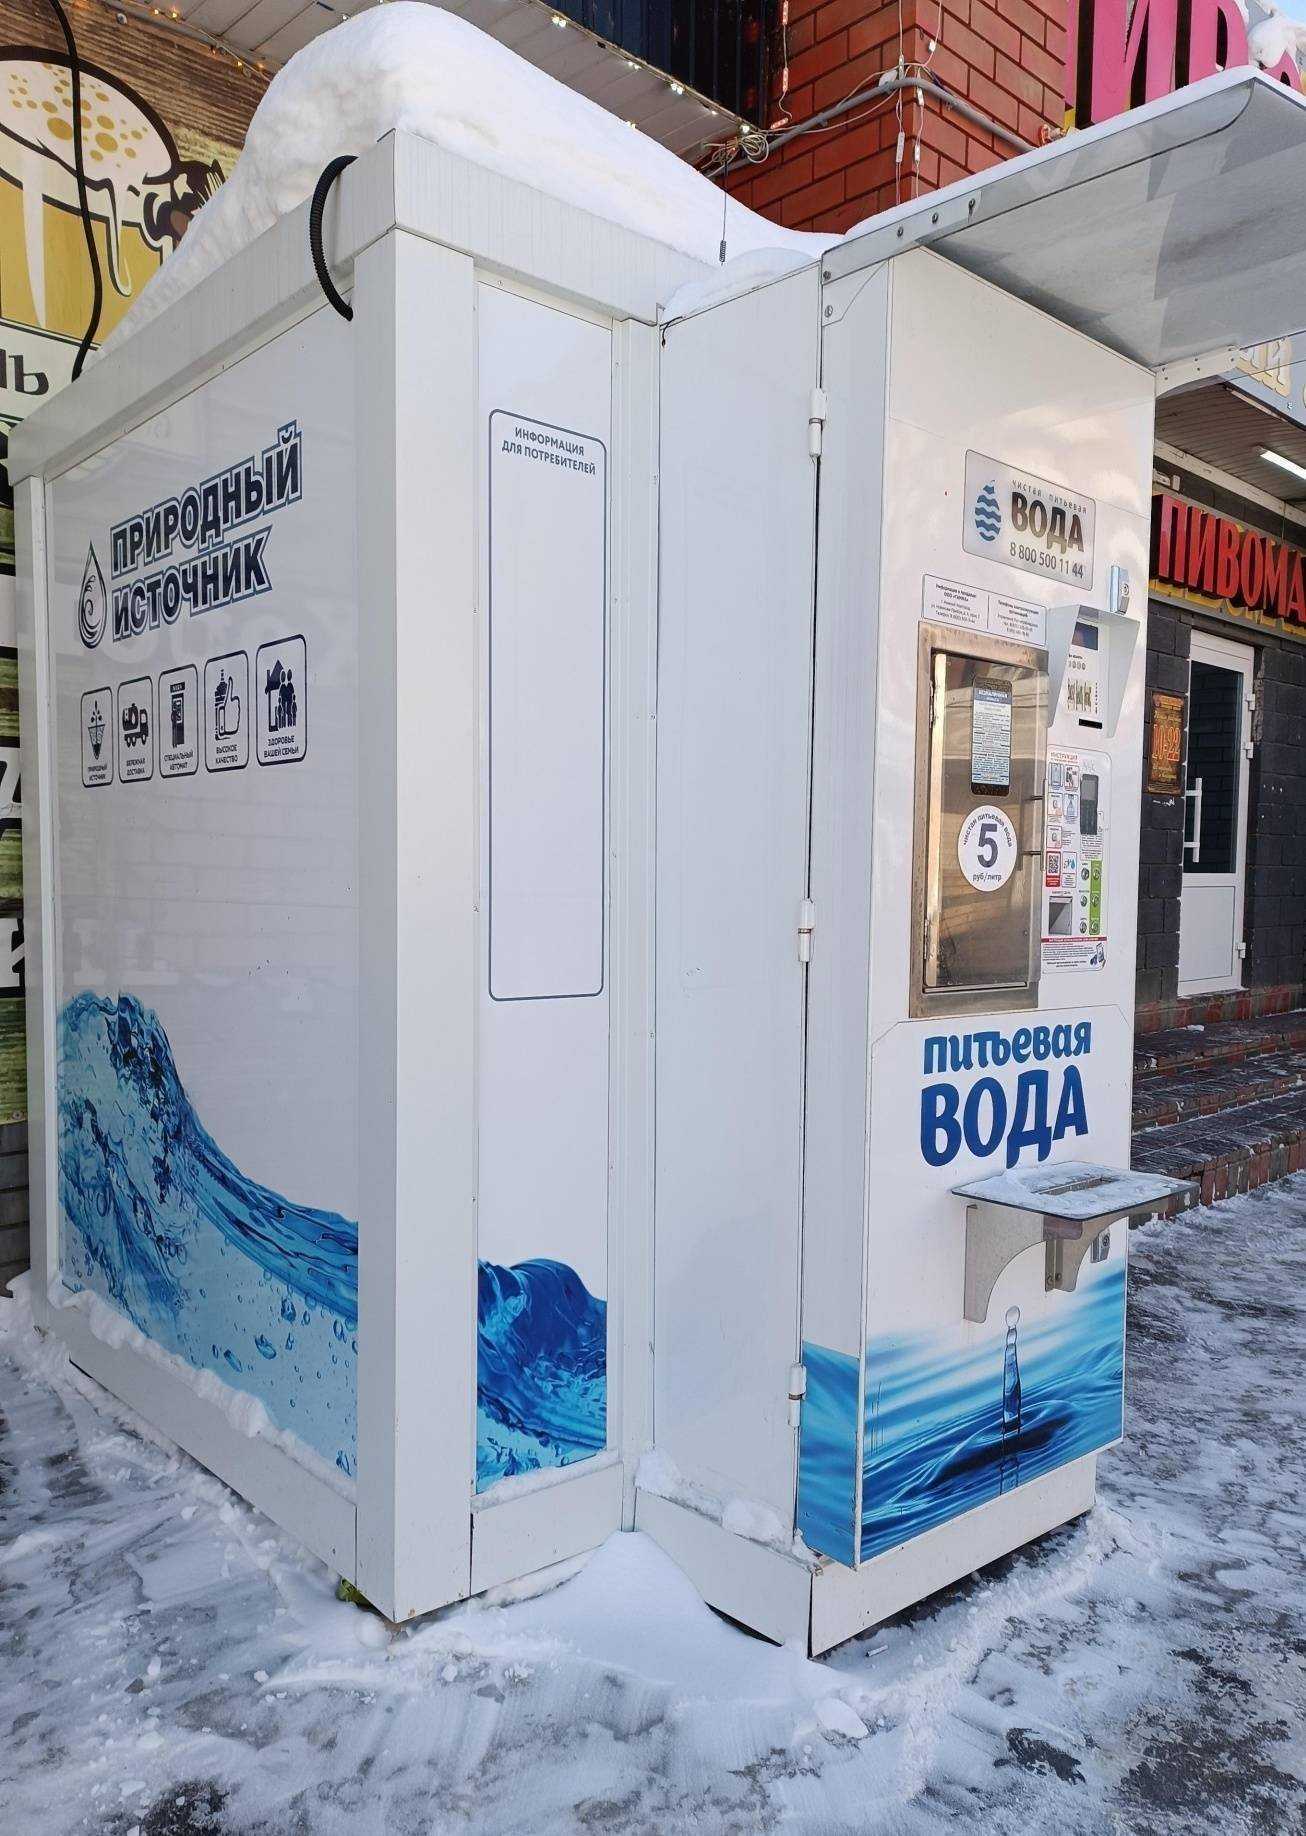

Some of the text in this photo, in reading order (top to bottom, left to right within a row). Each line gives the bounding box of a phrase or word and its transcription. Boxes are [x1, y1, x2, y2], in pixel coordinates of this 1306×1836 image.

[502, 440, 596, 475] ДЛЯ ПОТРЕБИТЕЛЕЙ
[515, 427, 584, 456] ИНФОРМАЦИЯ
[110, 420, 302, 580] ПРИРОДНЫЙ
[1012, 491, 1084, 555] ВОДА
[1010, 542, 1084, 578] 8 800 500 11 44
[111, 524, 273, 642] ИСТОЧНИК
[268, 735, 294, 746] ЗДОРОВЬЕ
[977, 823, 998, 868] 5
[972, 872, 1002, 882] руб/литр
[924, 1021, 1092, 1075] питьевая
[920, 1064, 1089, 1169] ВОДА
